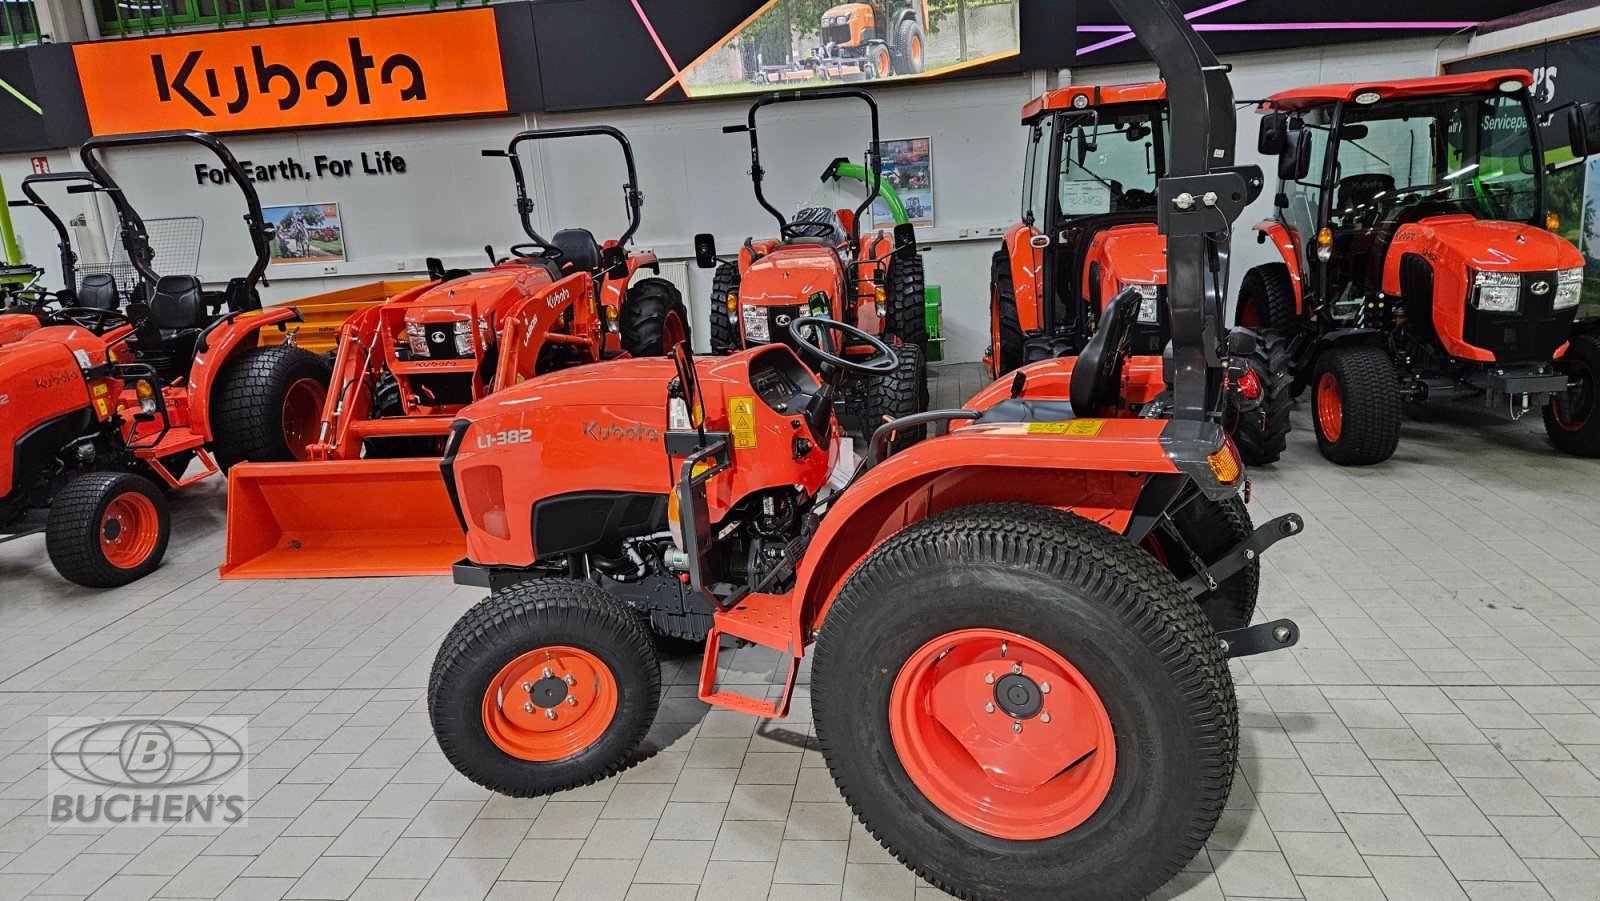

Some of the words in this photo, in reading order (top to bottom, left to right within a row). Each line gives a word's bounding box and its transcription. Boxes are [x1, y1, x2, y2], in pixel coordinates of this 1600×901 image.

[150, 37, 427, 117] Kubota
[194, 163, 232, 185] For
[238, 157, 310, 184] Earth,
[313, 155, 353, 177] For
[361, 150, 406, 174] Life
[546, 287, 570, 309] Kubota
[35, 370, 78, 389] Kubota
[477, 429, 532, 449] L1-382
[582, 421, 659, 442] Kubota
